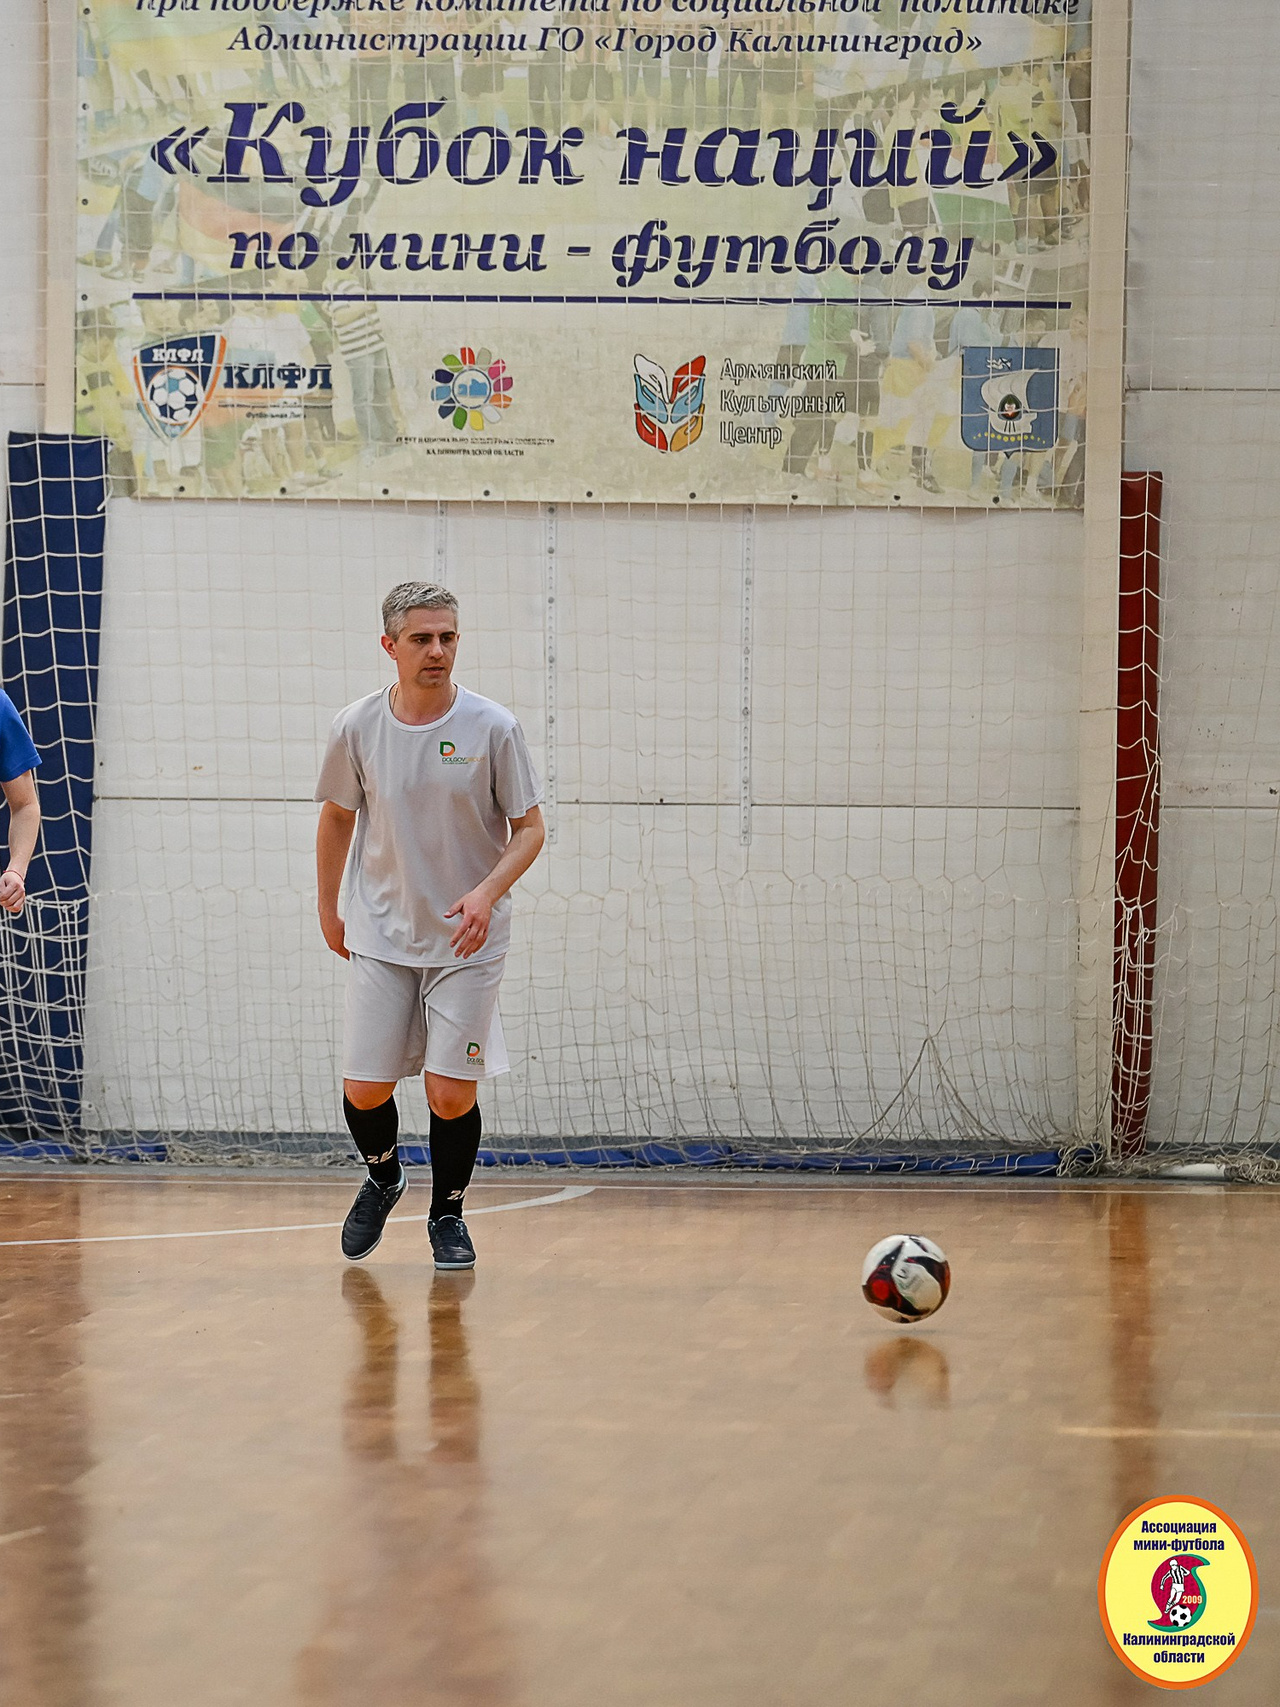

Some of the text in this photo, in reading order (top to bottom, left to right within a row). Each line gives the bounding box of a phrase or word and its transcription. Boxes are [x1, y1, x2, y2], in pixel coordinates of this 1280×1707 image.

[136, 0, 200, 17] при
[620, 0, 662, 12] по
[226, 24, 983, 60] Администрации ГО «Город Калининград»
[150, 98, 1059, 212] «Кубок наций»
[228, 230, 321, 271] по
[335, 232, 548, 272] мини
[611, 217, 975, 291] футболу
[152, 347, 204, 362] КЛФЛ
[223, 362, 332, 389] КЛФЛ
[720, 357, 838, 386] Армянский
[720, 389, 847, 418] Культурный
[720, 421, 783, 450] Центр
